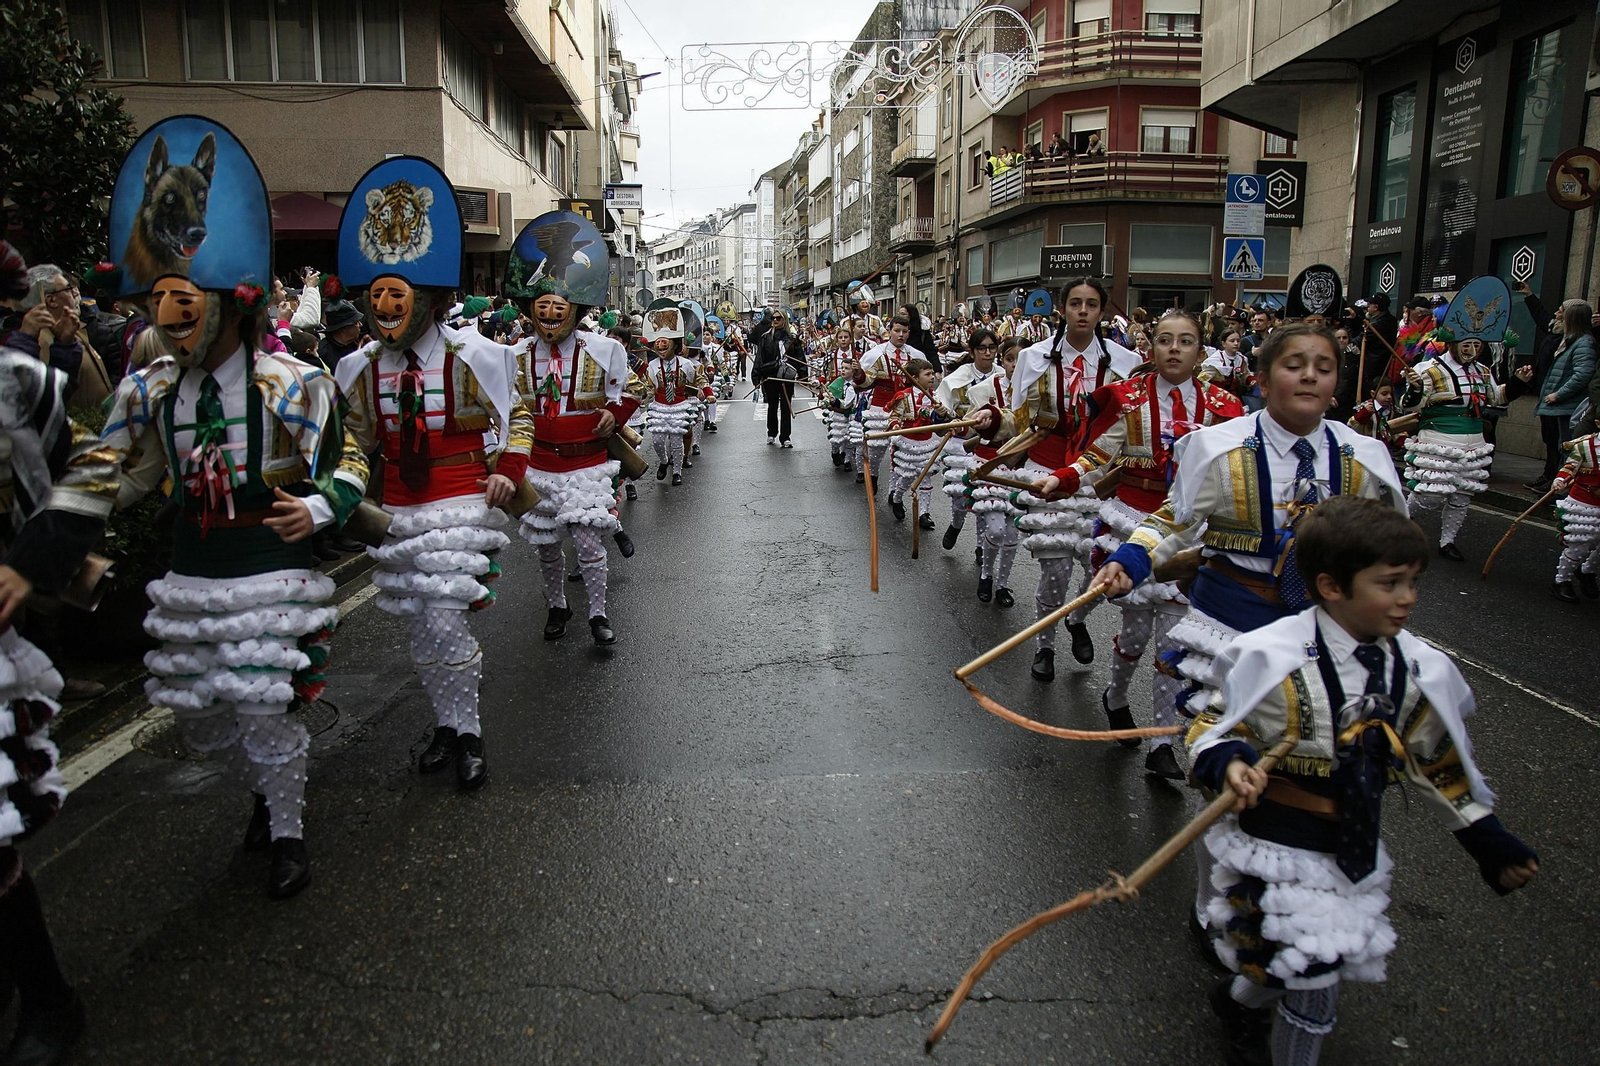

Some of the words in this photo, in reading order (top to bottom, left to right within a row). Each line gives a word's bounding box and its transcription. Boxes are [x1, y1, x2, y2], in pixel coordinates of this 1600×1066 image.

[1444, 76, 1482, 97] Dentalnova
[1454, 109, 1467, 118] Centro
[1468, 104, 1481, 113] Dental
[1369, 226, 1402, 238] Dentalnova
[1050, 253, 1093, 262] FLORENTINO
